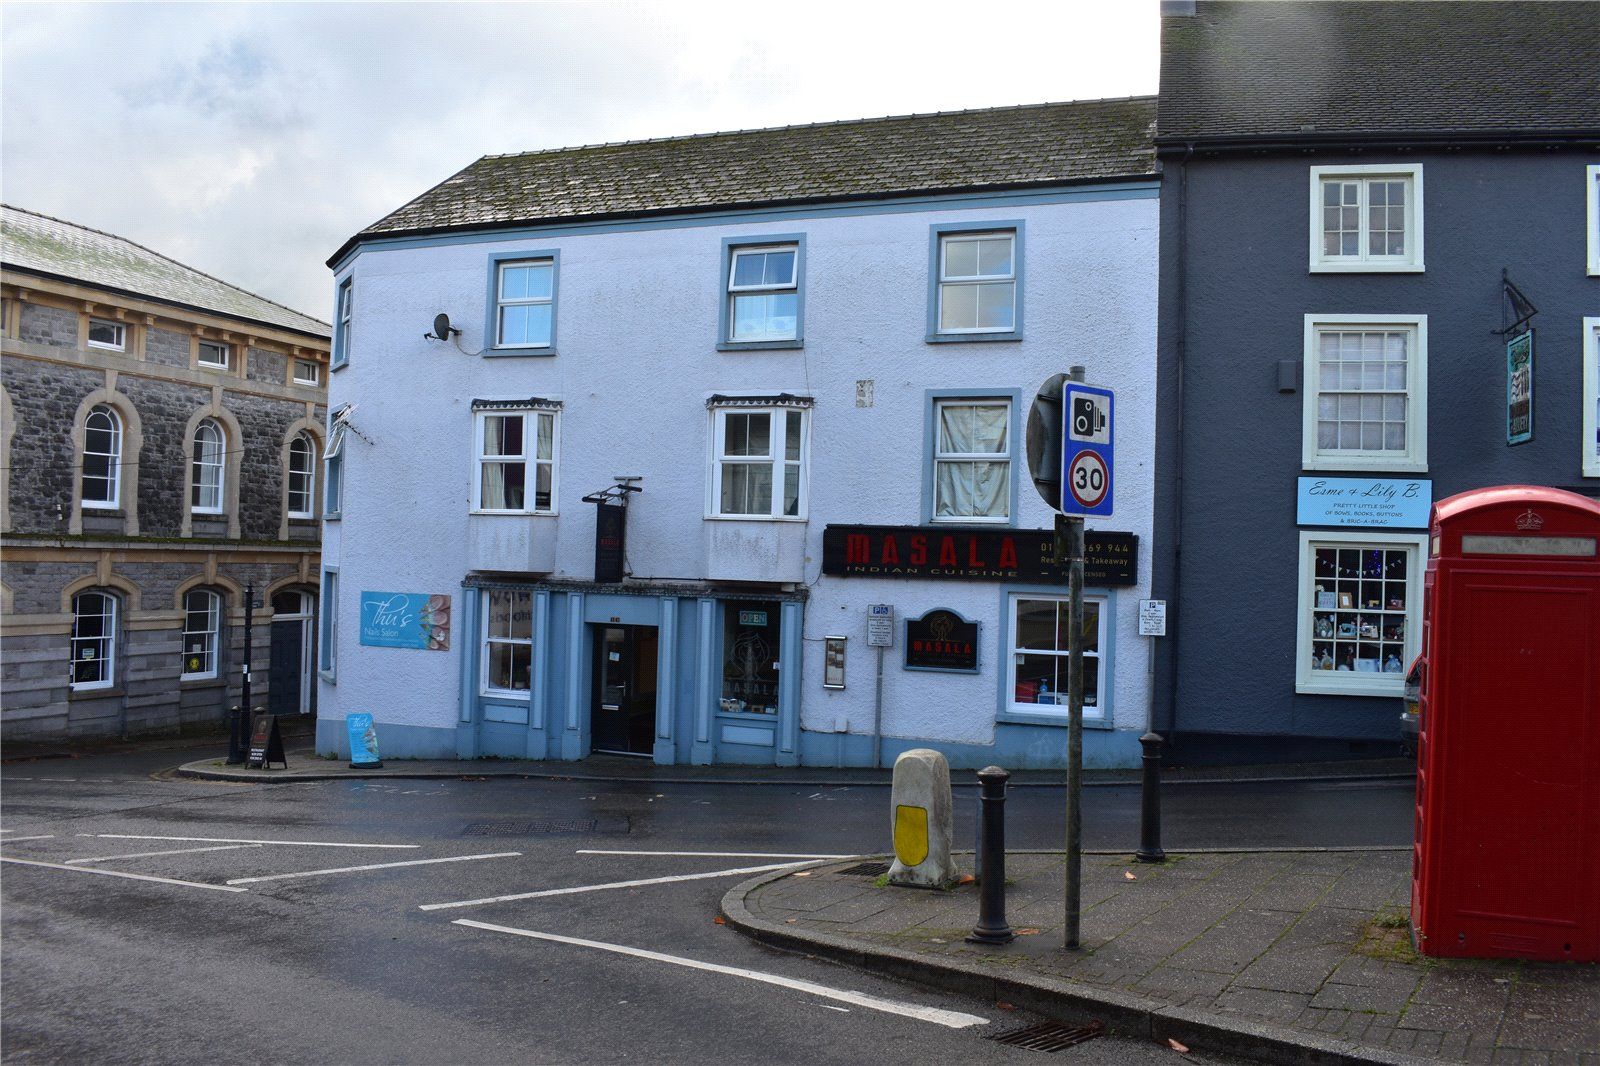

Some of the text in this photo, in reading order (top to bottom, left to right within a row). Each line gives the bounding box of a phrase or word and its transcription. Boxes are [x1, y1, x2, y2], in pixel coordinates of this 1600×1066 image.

[1075, 466, 1103, 491] 30
[1309, 481, 1344, 496] Esme
[1361, 483, 1397, 502] Lily
[1402, 483, 1419, 498] B.
[846, 533, 1018, 568] MASALA
[1107, 544, 1129, 553] 944
[1092, 557, 1128, 566] Takeaway
[846, 565, 1018, 577] INDIAN CUISINE
[364, 594, 413, 627] Thu's
[741, 614, 766, 623] OPEN
[364, 628, 399, 638] Nails Salon
[913, 640, 972, 655] MASALA
